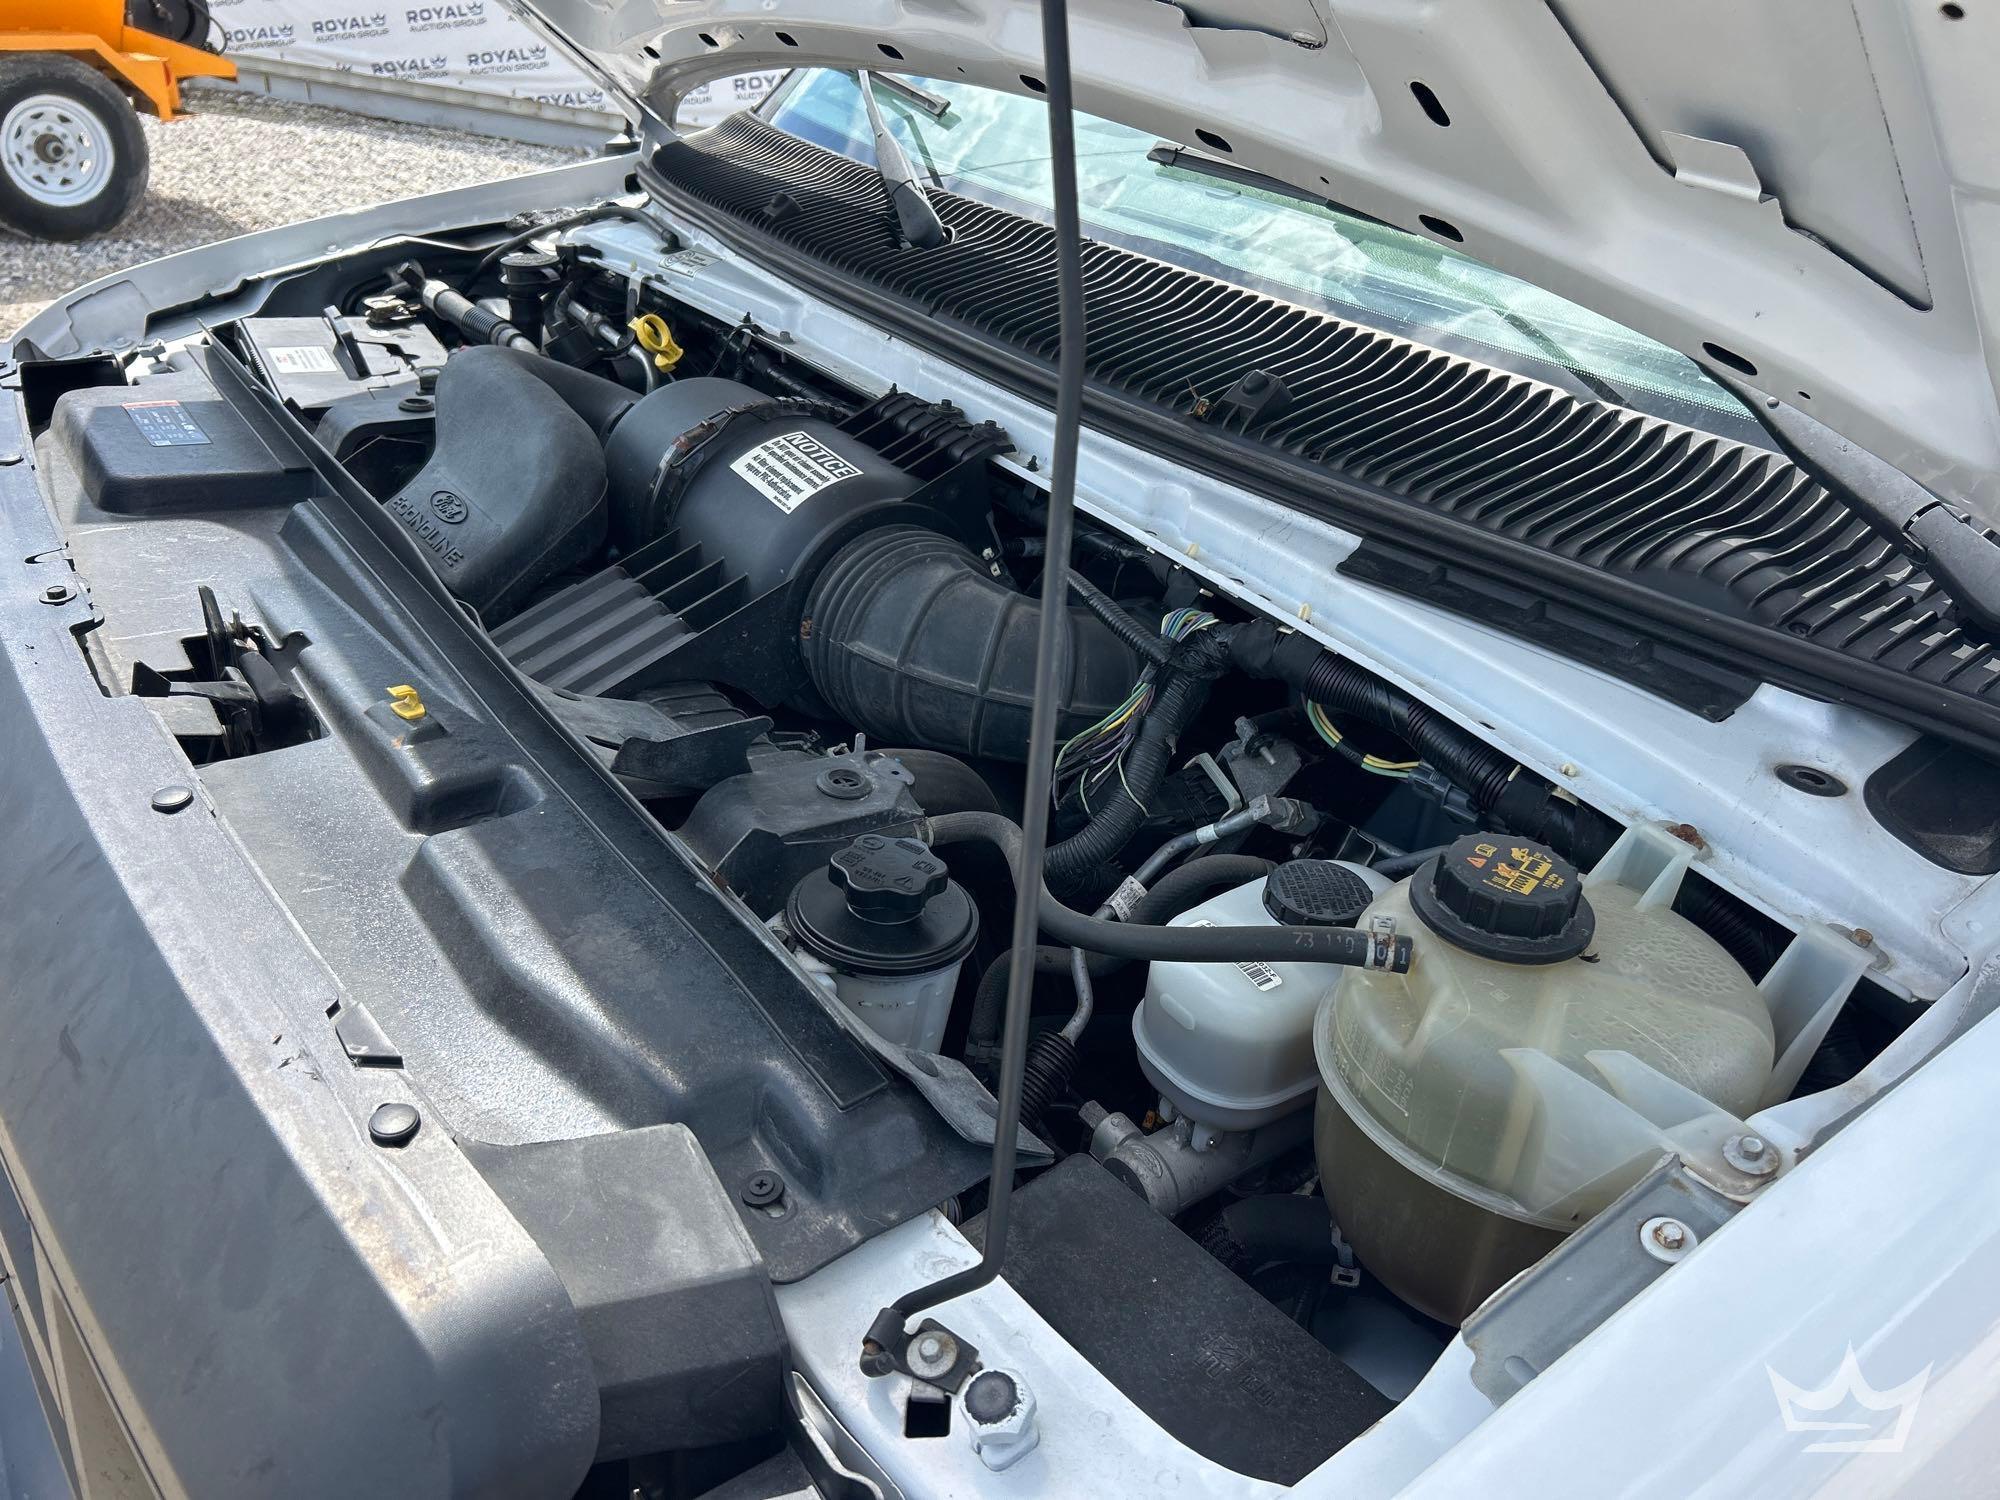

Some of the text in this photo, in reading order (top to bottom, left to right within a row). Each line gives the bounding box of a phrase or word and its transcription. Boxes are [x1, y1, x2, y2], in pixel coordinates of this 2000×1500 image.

[406, 3, 466, 23] ROYAL
[224, 25, 279, 42] ROYAL
[312, 16, 371, 34] ROYAL
[409, 17, 488, 33] AUCTION GROUP
[315, 28, 390, 43] AUCTION GROUP
[467, 47, 529, 66] ROYAL
[371, 59, 430, 74] ROYAL
[470, 61, 549, 75] AUCTION GROUP
[734, 76, 776, 91] ROY
[776, 443, 791, 452] NOT
[810, 469, 831, 486] assembly
[786, 433, 857, 478] NOTICE
[744, 462, 762, 477] requires
[767, 450, 789, 464] specified
[783, 461, 808, 480] maintenance
[765, 465, 784, 479] element
[779, 475, 805, 495] replacement
[391, 497, 464, 567] ECONOLINE
